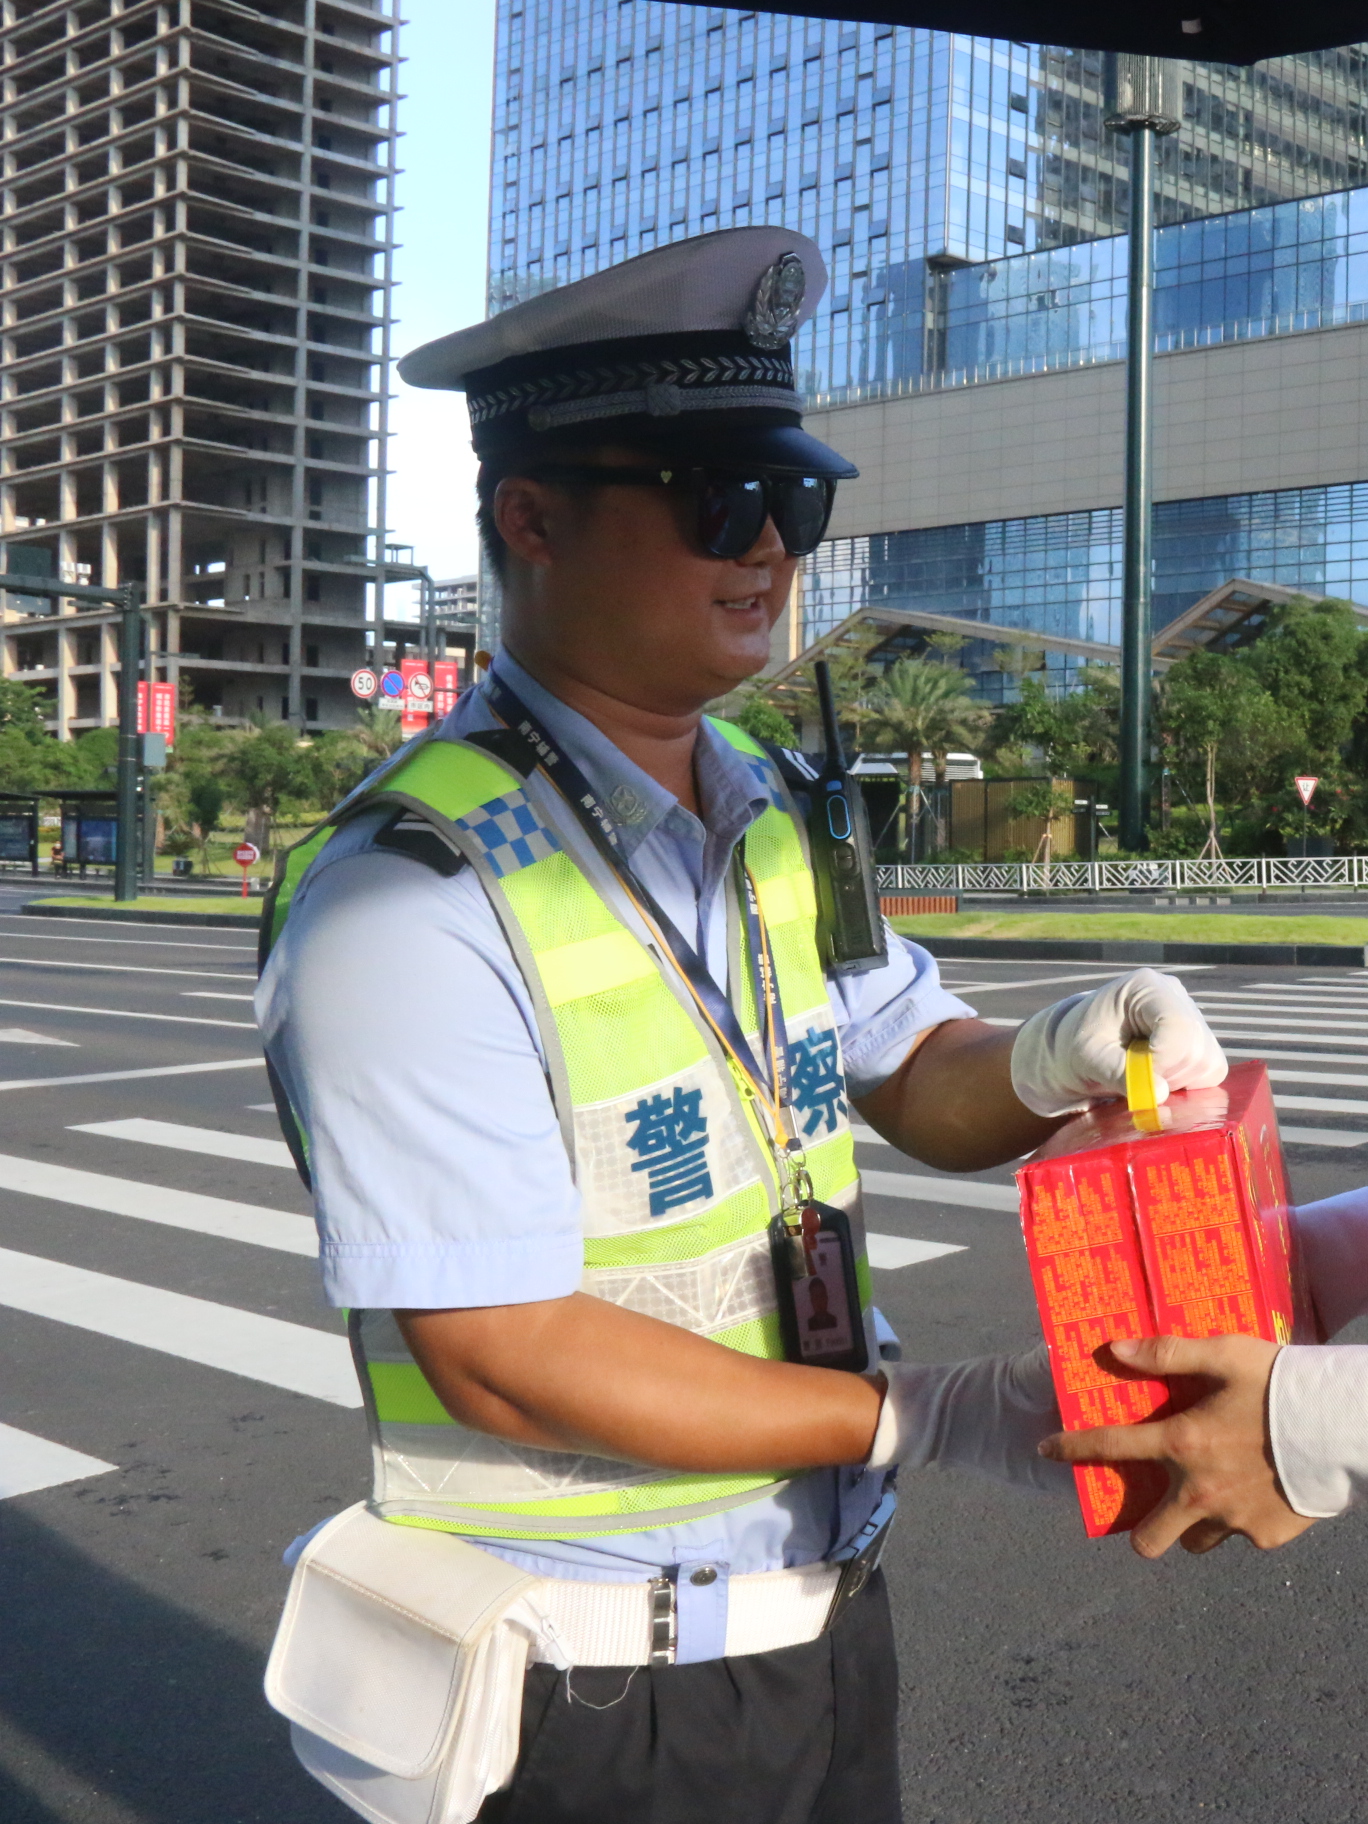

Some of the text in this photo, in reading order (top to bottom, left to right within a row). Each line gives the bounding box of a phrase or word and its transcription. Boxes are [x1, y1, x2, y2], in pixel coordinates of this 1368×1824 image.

[357, 677, 373, 690] 50
[518, 720, 560, 767] 南宁辅警
[1302, 782, 1310, 791] 让
[580, 793, 618, 846] 南宁辅警
[624, 1026, 849, 1217] 警 察
